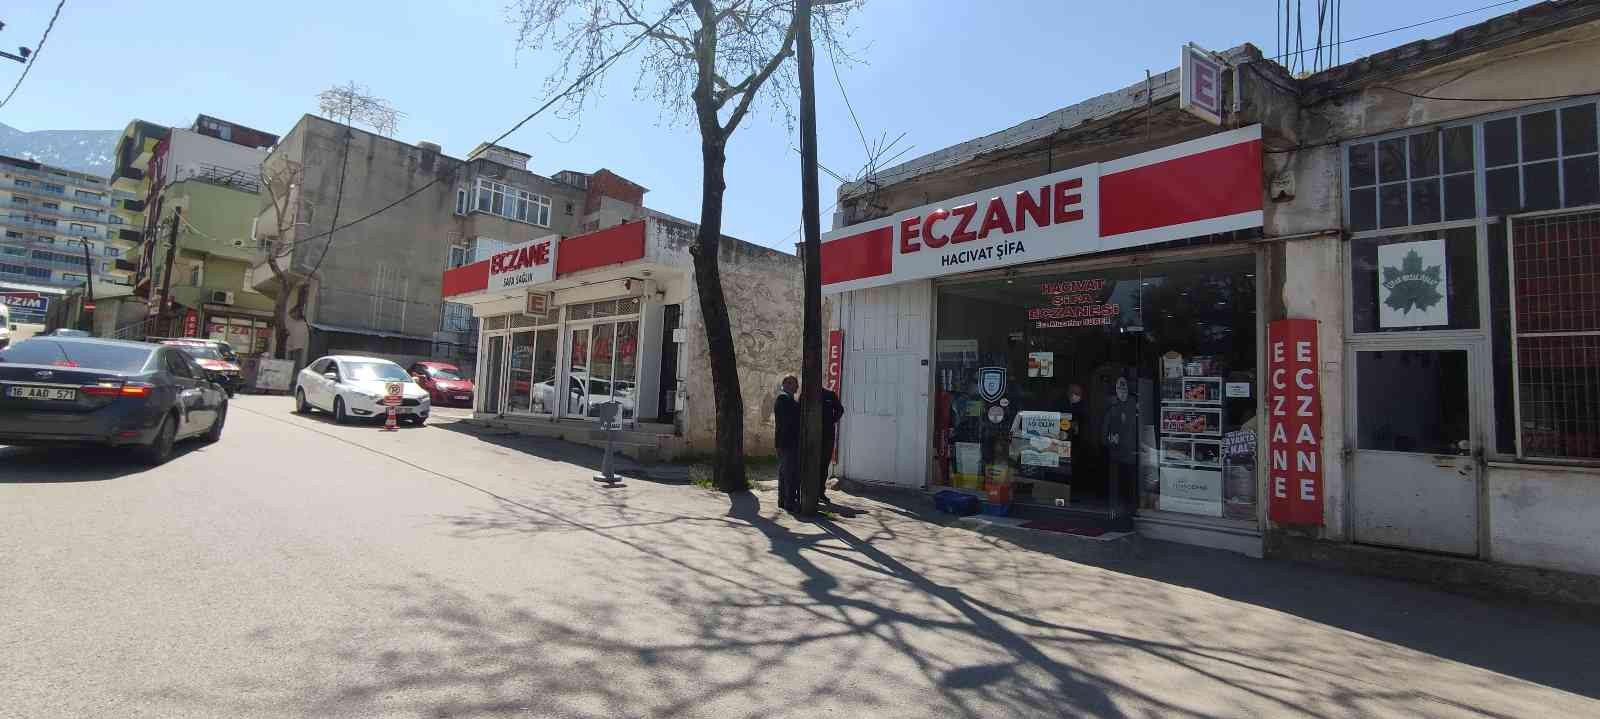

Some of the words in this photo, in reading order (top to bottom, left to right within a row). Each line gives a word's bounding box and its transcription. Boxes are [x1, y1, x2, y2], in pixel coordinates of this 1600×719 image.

[1196, 63, 1214, 107] E
[900, 176, 1084, 254] ECZANE
[491, 240, 550, 275] ECZANE
[941, 246, 994, 267] HACIVAT
[996, 240, 1025, 260] ŞİFA
[531, 296, 544, 311] E
[13, 387, 23, 397] 16
[56, 390, 75, 399] 571
[1273, 342, 1287, 498] ECZANE
[1295, 341, 1316, 501] ECZANE
